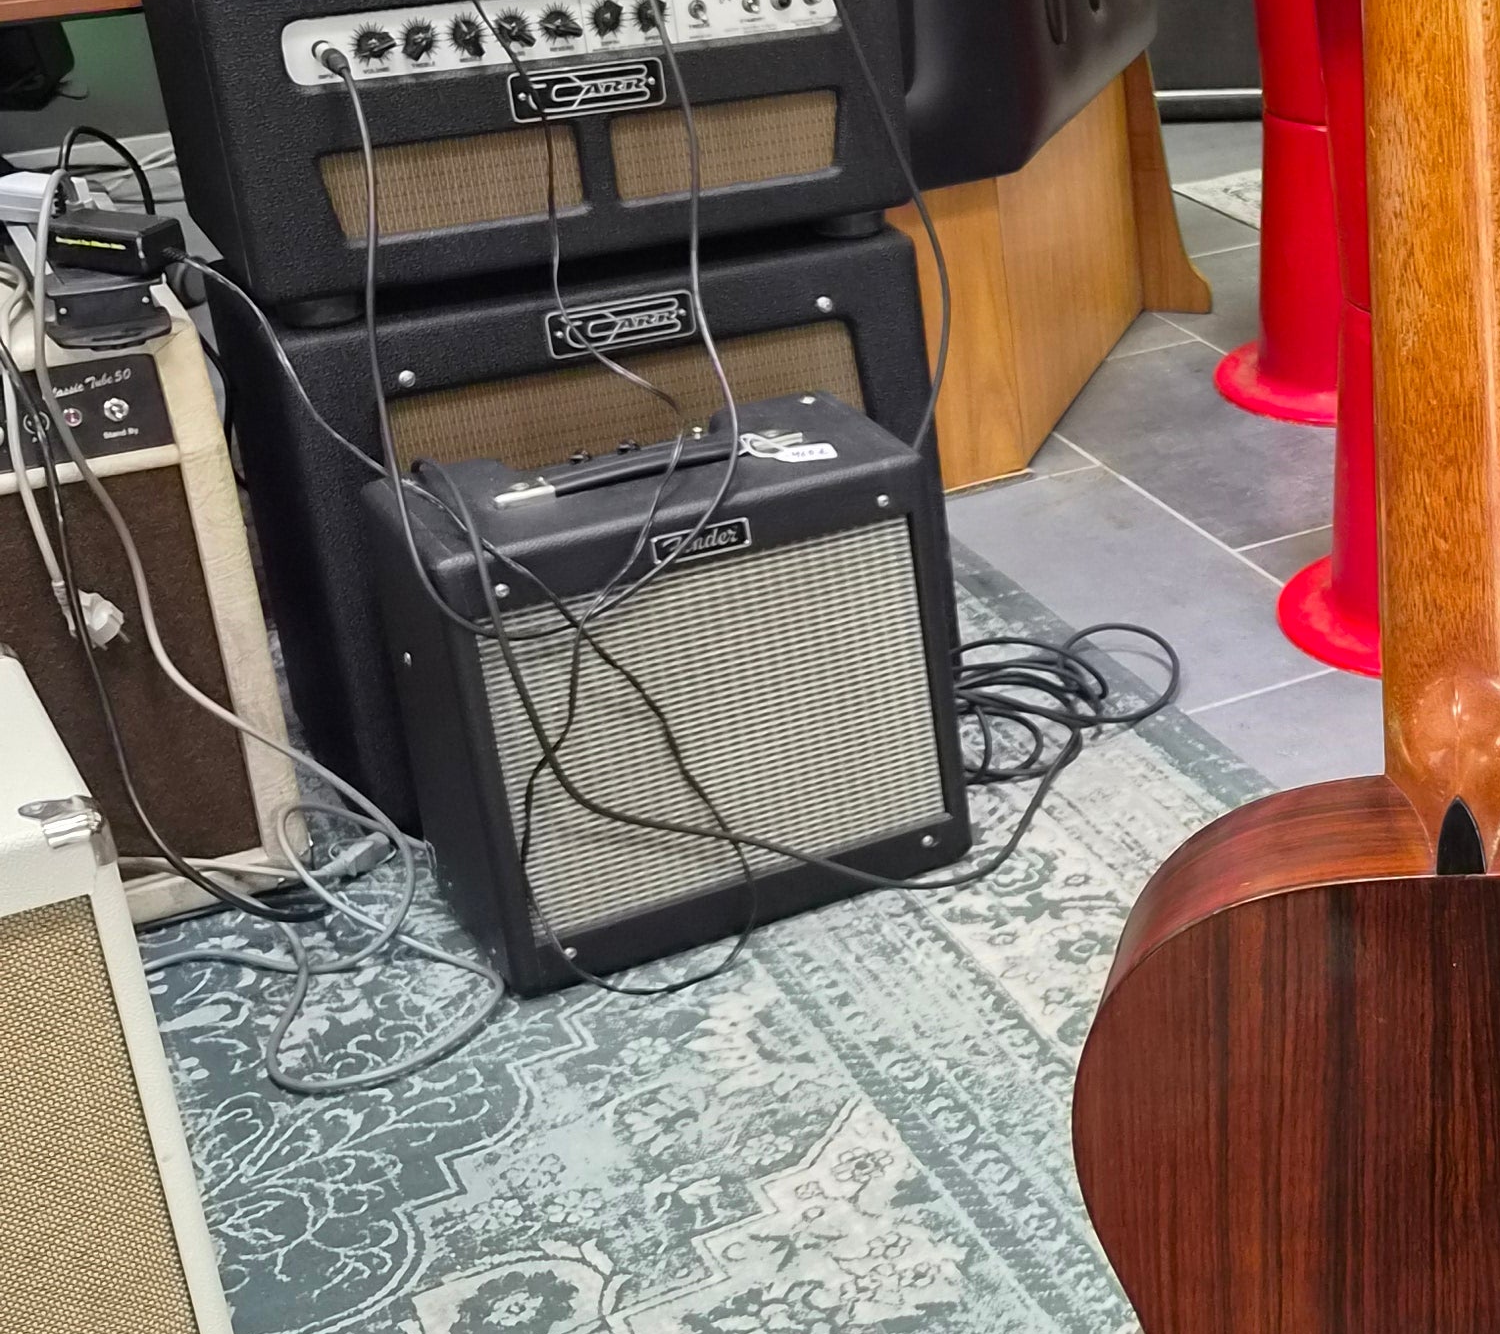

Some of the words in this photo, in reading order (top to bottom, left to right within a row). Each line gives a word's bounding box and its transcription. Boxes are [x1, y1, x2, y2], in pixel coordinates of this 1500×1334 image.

[84, 373, 114, 389] Tube
[114, 368, 132, 383] 50
[662, 526, 740, 554] Fnder
